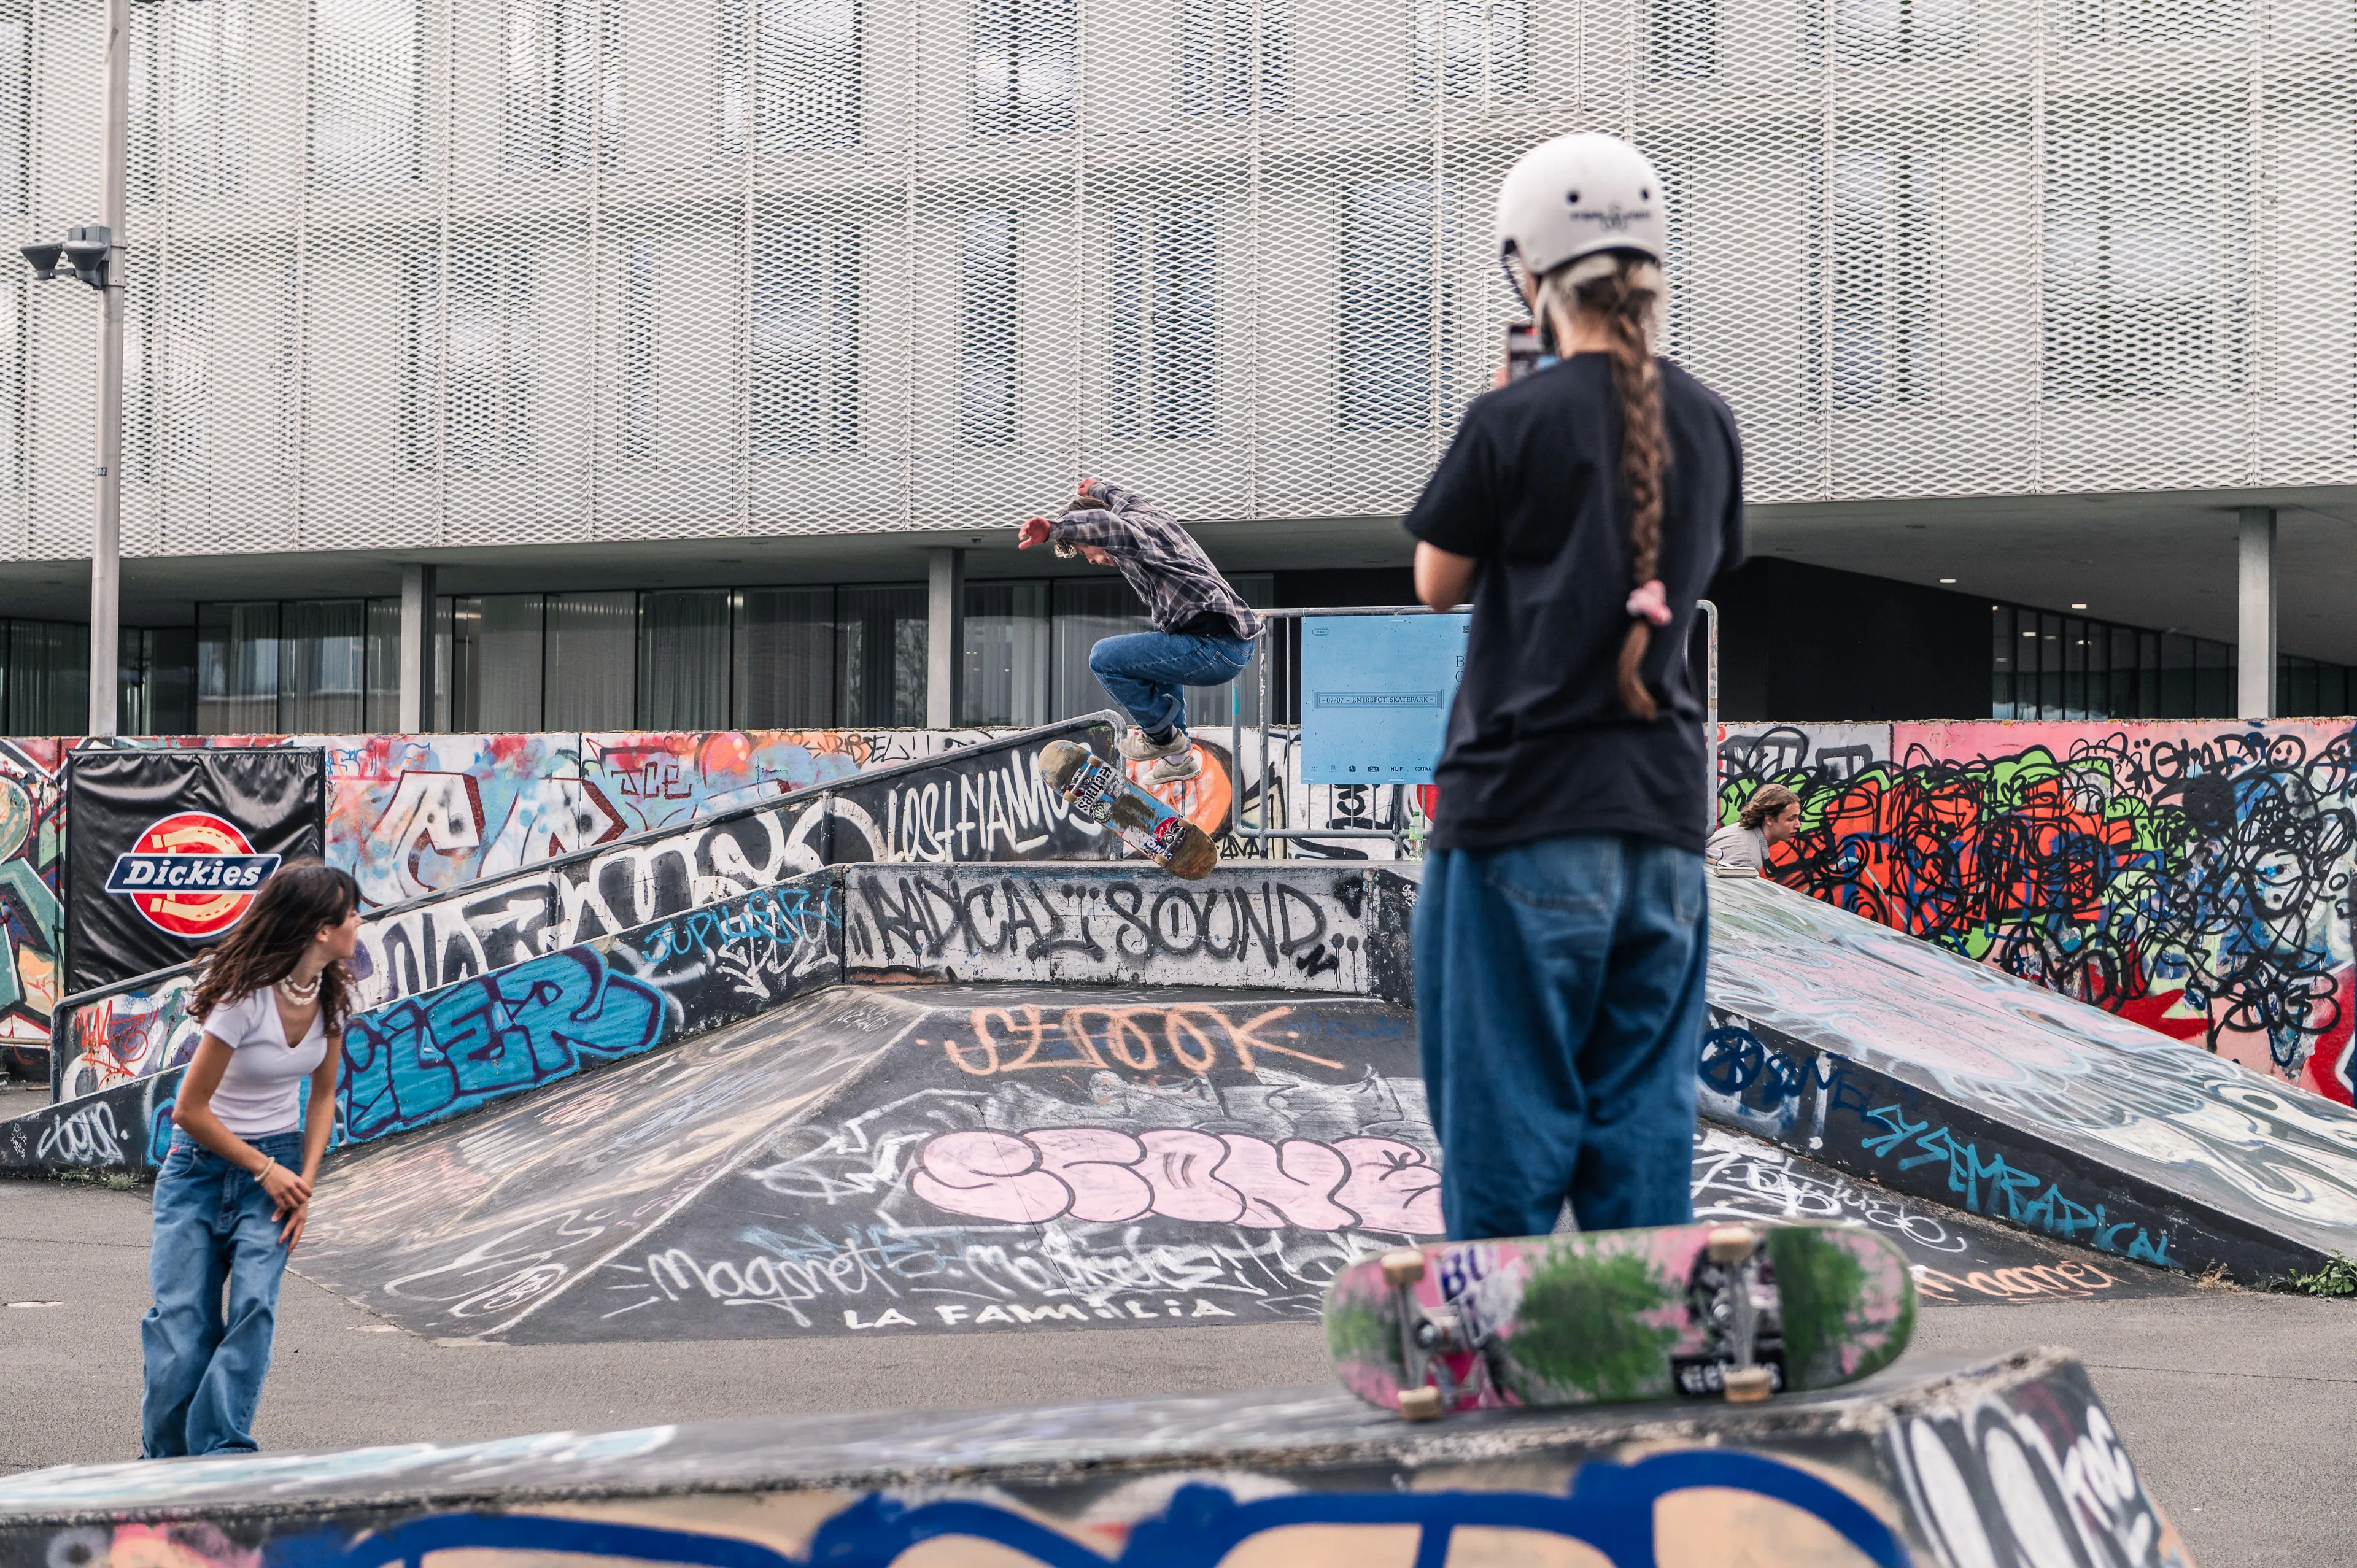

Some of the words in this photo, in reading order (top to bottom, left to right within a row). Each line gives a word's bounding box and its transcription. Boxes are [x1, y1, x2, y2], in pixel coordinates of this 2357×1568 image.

[123, 860, 263, 886] Dickies
[1105, 881, 1327, 967] SOUND
[843, 1308, 917, 1330] LA
